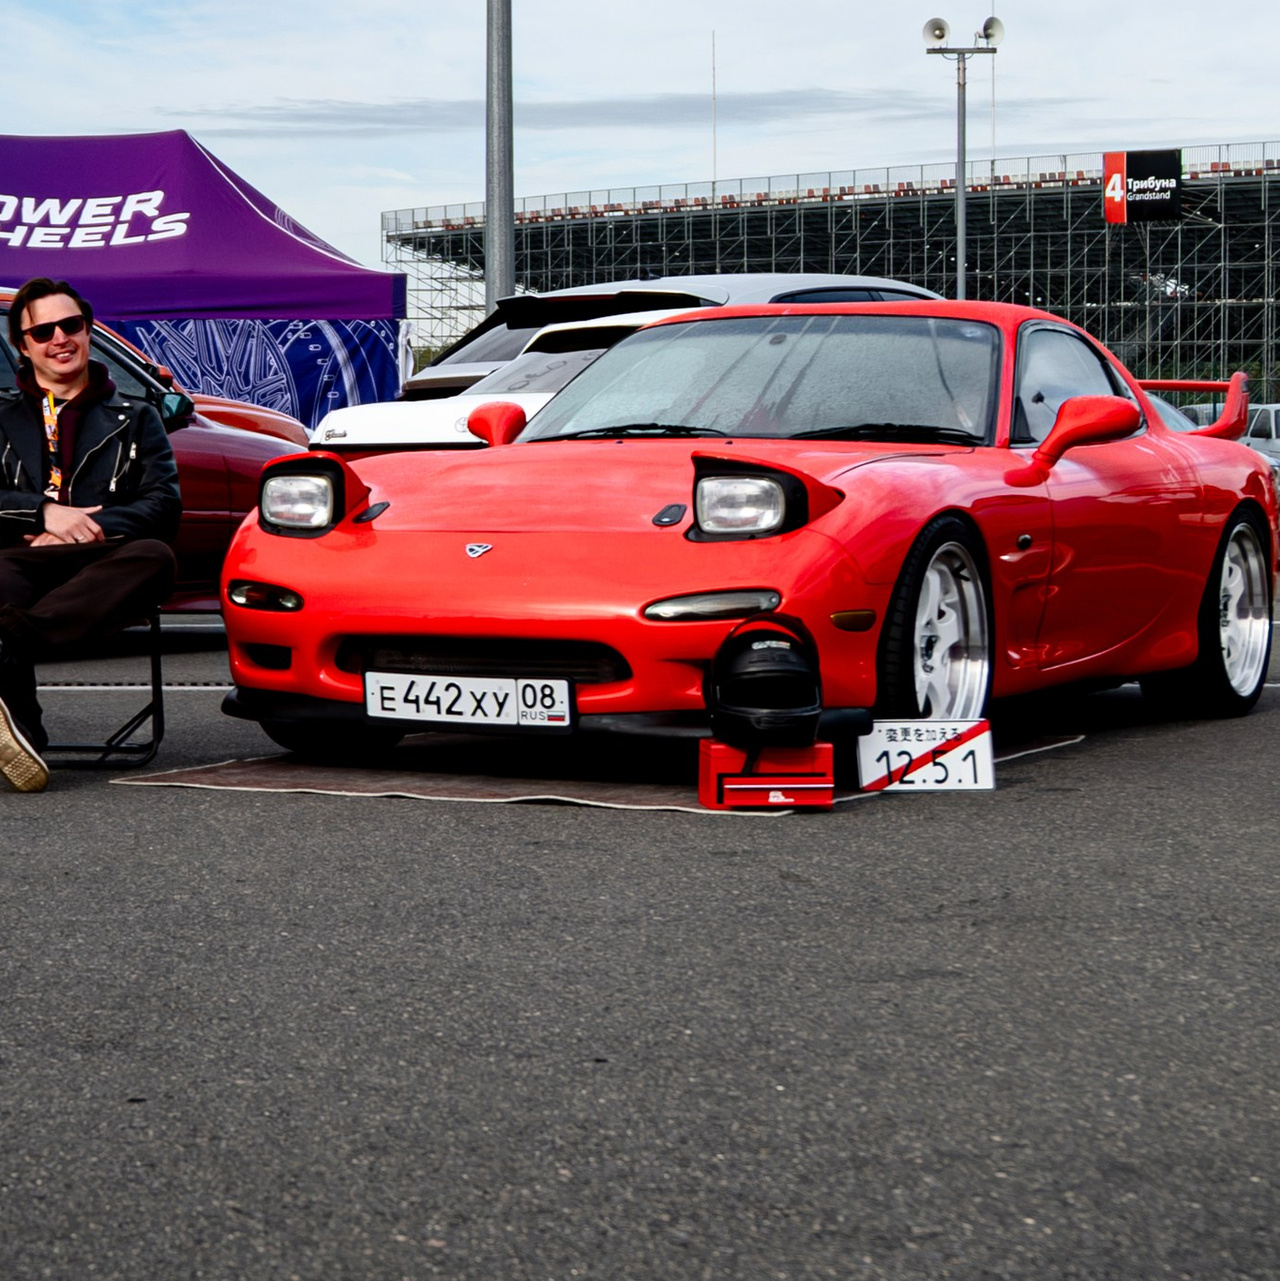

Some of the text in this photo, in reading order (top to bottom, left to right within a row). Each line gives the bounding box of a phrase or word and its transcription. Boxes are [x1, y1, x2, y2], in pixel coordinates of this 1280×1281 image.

[1105, 173, 1124, 202] 4
[1127, 177, 1176, 192] Трибуна
[1127, 191, 1171, 200] Grandstand
[521, 683, 556, 709] 08
[521, 711, 546, 720] RUS
[886, 728, 962, 742] 変更を加える
[876, 750, 978, 784] 12.5.1
